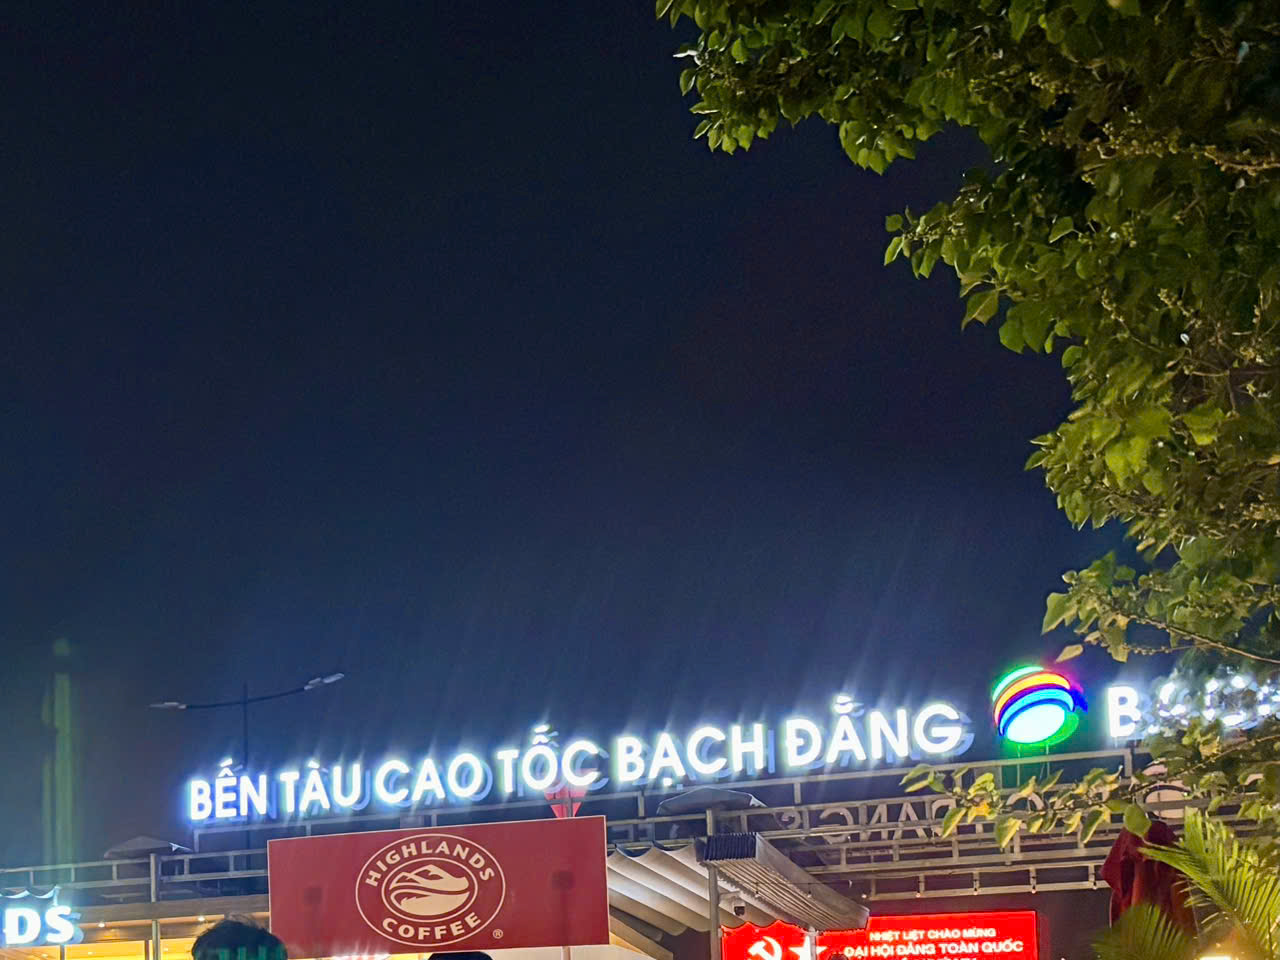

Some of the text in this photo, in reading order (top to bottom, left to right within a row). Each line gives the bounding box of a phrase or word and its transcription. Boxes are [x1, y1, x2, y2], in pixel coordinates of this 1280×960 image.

[189, 695, 963, 820] BẾN TÀU CAO TỐC BẠCH ĐẰNG
[366, 840, 495, 888] HIGHLANDS
[381, 912, 481, 941] COFFEE
